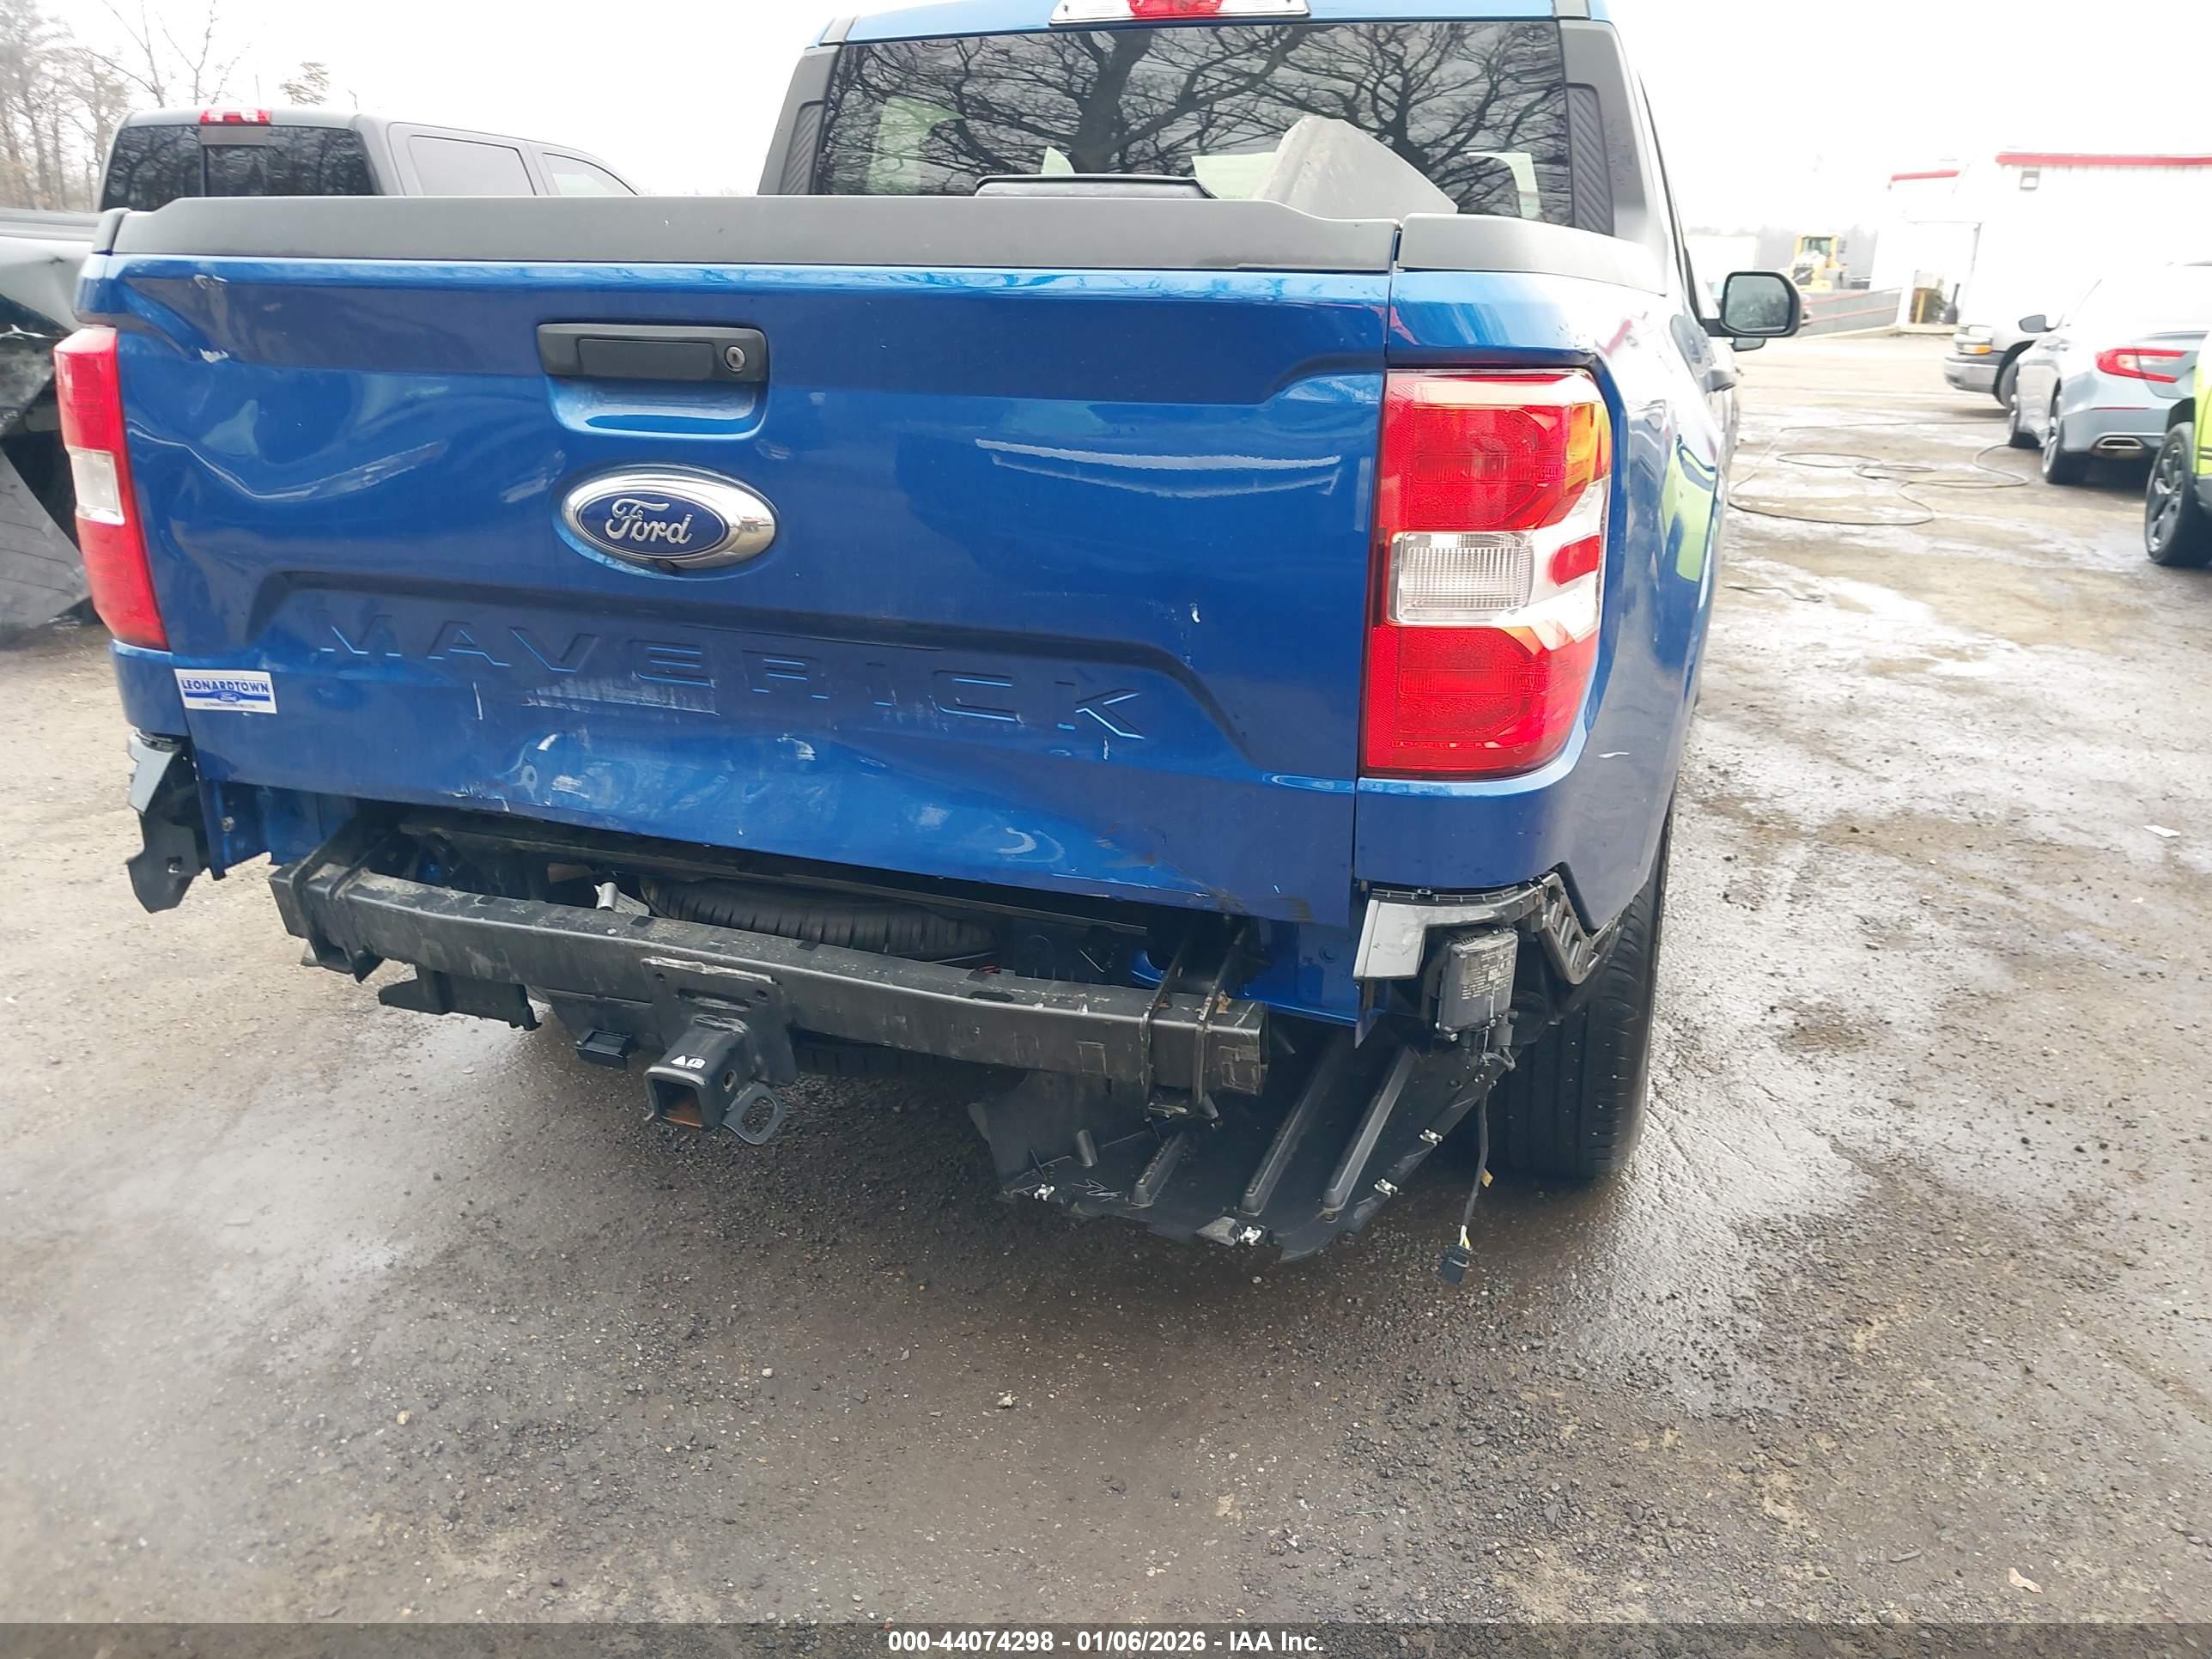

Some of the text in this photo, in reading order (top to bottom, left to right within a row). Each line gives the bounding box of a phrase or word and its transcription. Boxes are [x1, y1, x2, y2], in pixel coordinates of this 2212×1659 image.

[605, 498, 694, 544] Ford
[180, 679, 269, 693] LEONARDTOWN
[314, 610, 1146, 740] MAVERICK
